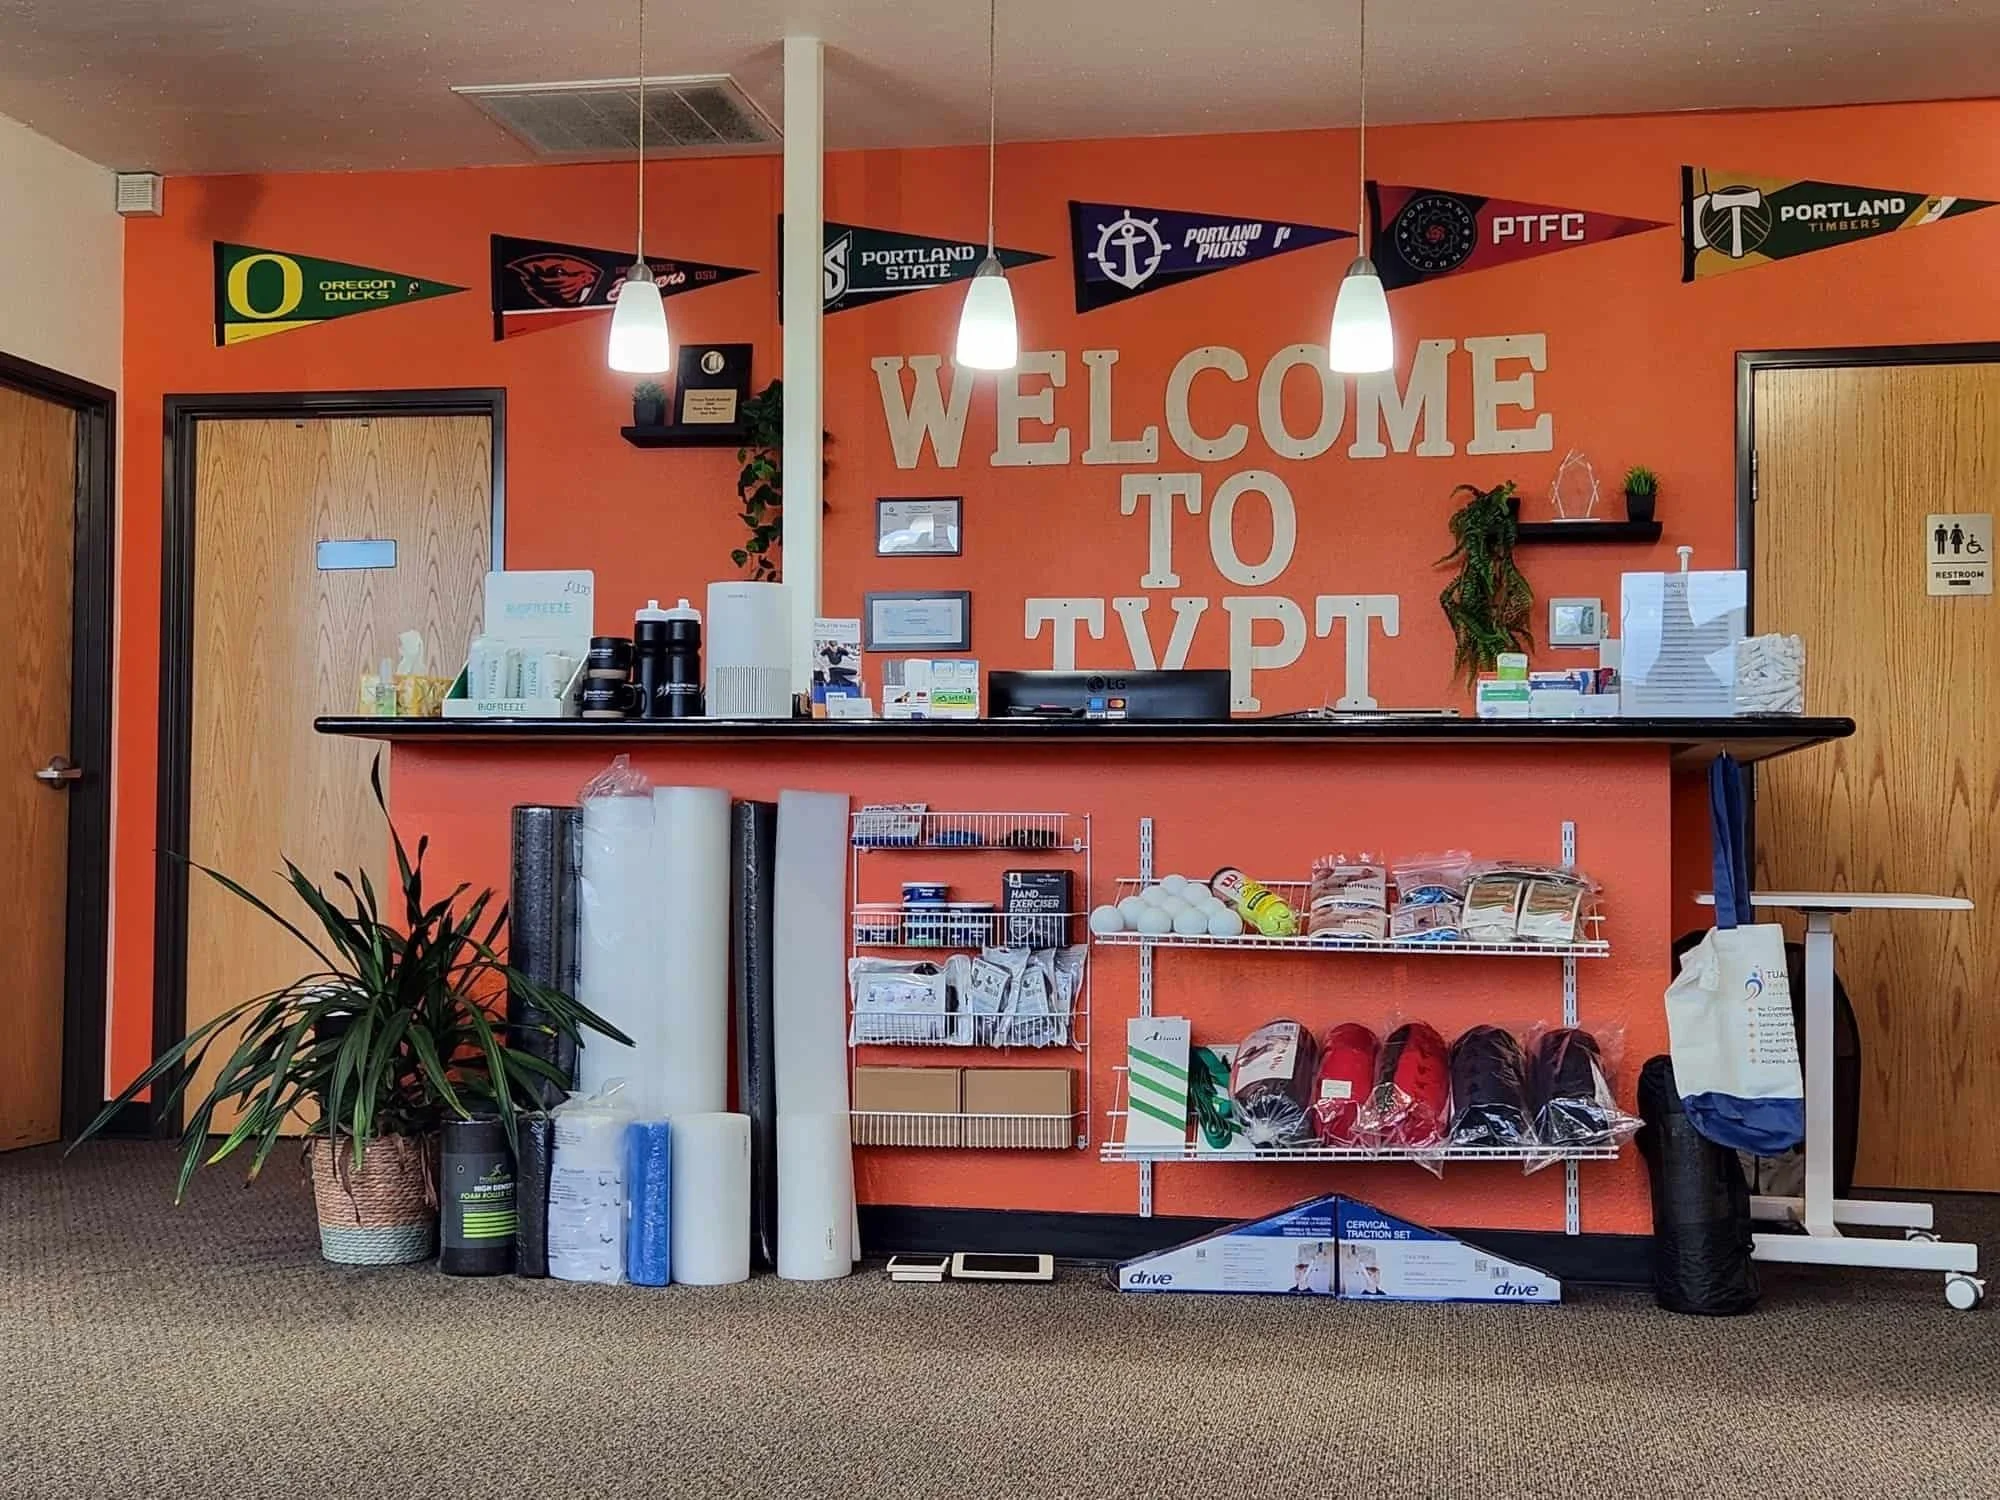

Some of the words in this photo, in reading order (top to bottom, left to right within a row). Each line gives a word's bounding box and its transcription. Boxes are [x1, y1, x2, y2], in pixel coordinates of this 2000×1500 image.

[1780, 197, 1907, 223] PORTLAND
[1492, 212, 1585, 244] PTFC
[1807, 218, 1882, 233] TIMBERS
[1184, 223, 1263, 248] PORTLAND
[861, 246, 976, 267] PORTLAND
[1196, 240, 1249, 263] PILOTS
[886, 264, 951, 281] STATE
[228, 253, 303, 319] O
[319, 279, 396, 291] OREGON
[325, 291, 389, 301] DUCKS
[871, 333, 1553, 469] WELCOME
[1120, 469, 1297, 589] TO
[1935, 571, 1985, 579] RESTROOM
[1107, 679, 1127, 690] LG
[1011, 889, 1039, 899] HAND
[1009, 899, 1060, 909] EXERCISER
[460, 1192, 481, 1200] FOAM
[1346, 1220, 1391, 1230] CERVICAL
[1346, 1230, 1391, 1239] TRACTION
[1393, 1231, 1411, 1240] SET
[1129, 1270, 1173, 1285] drive
[1494, 1280, 1540, 1297] drive
